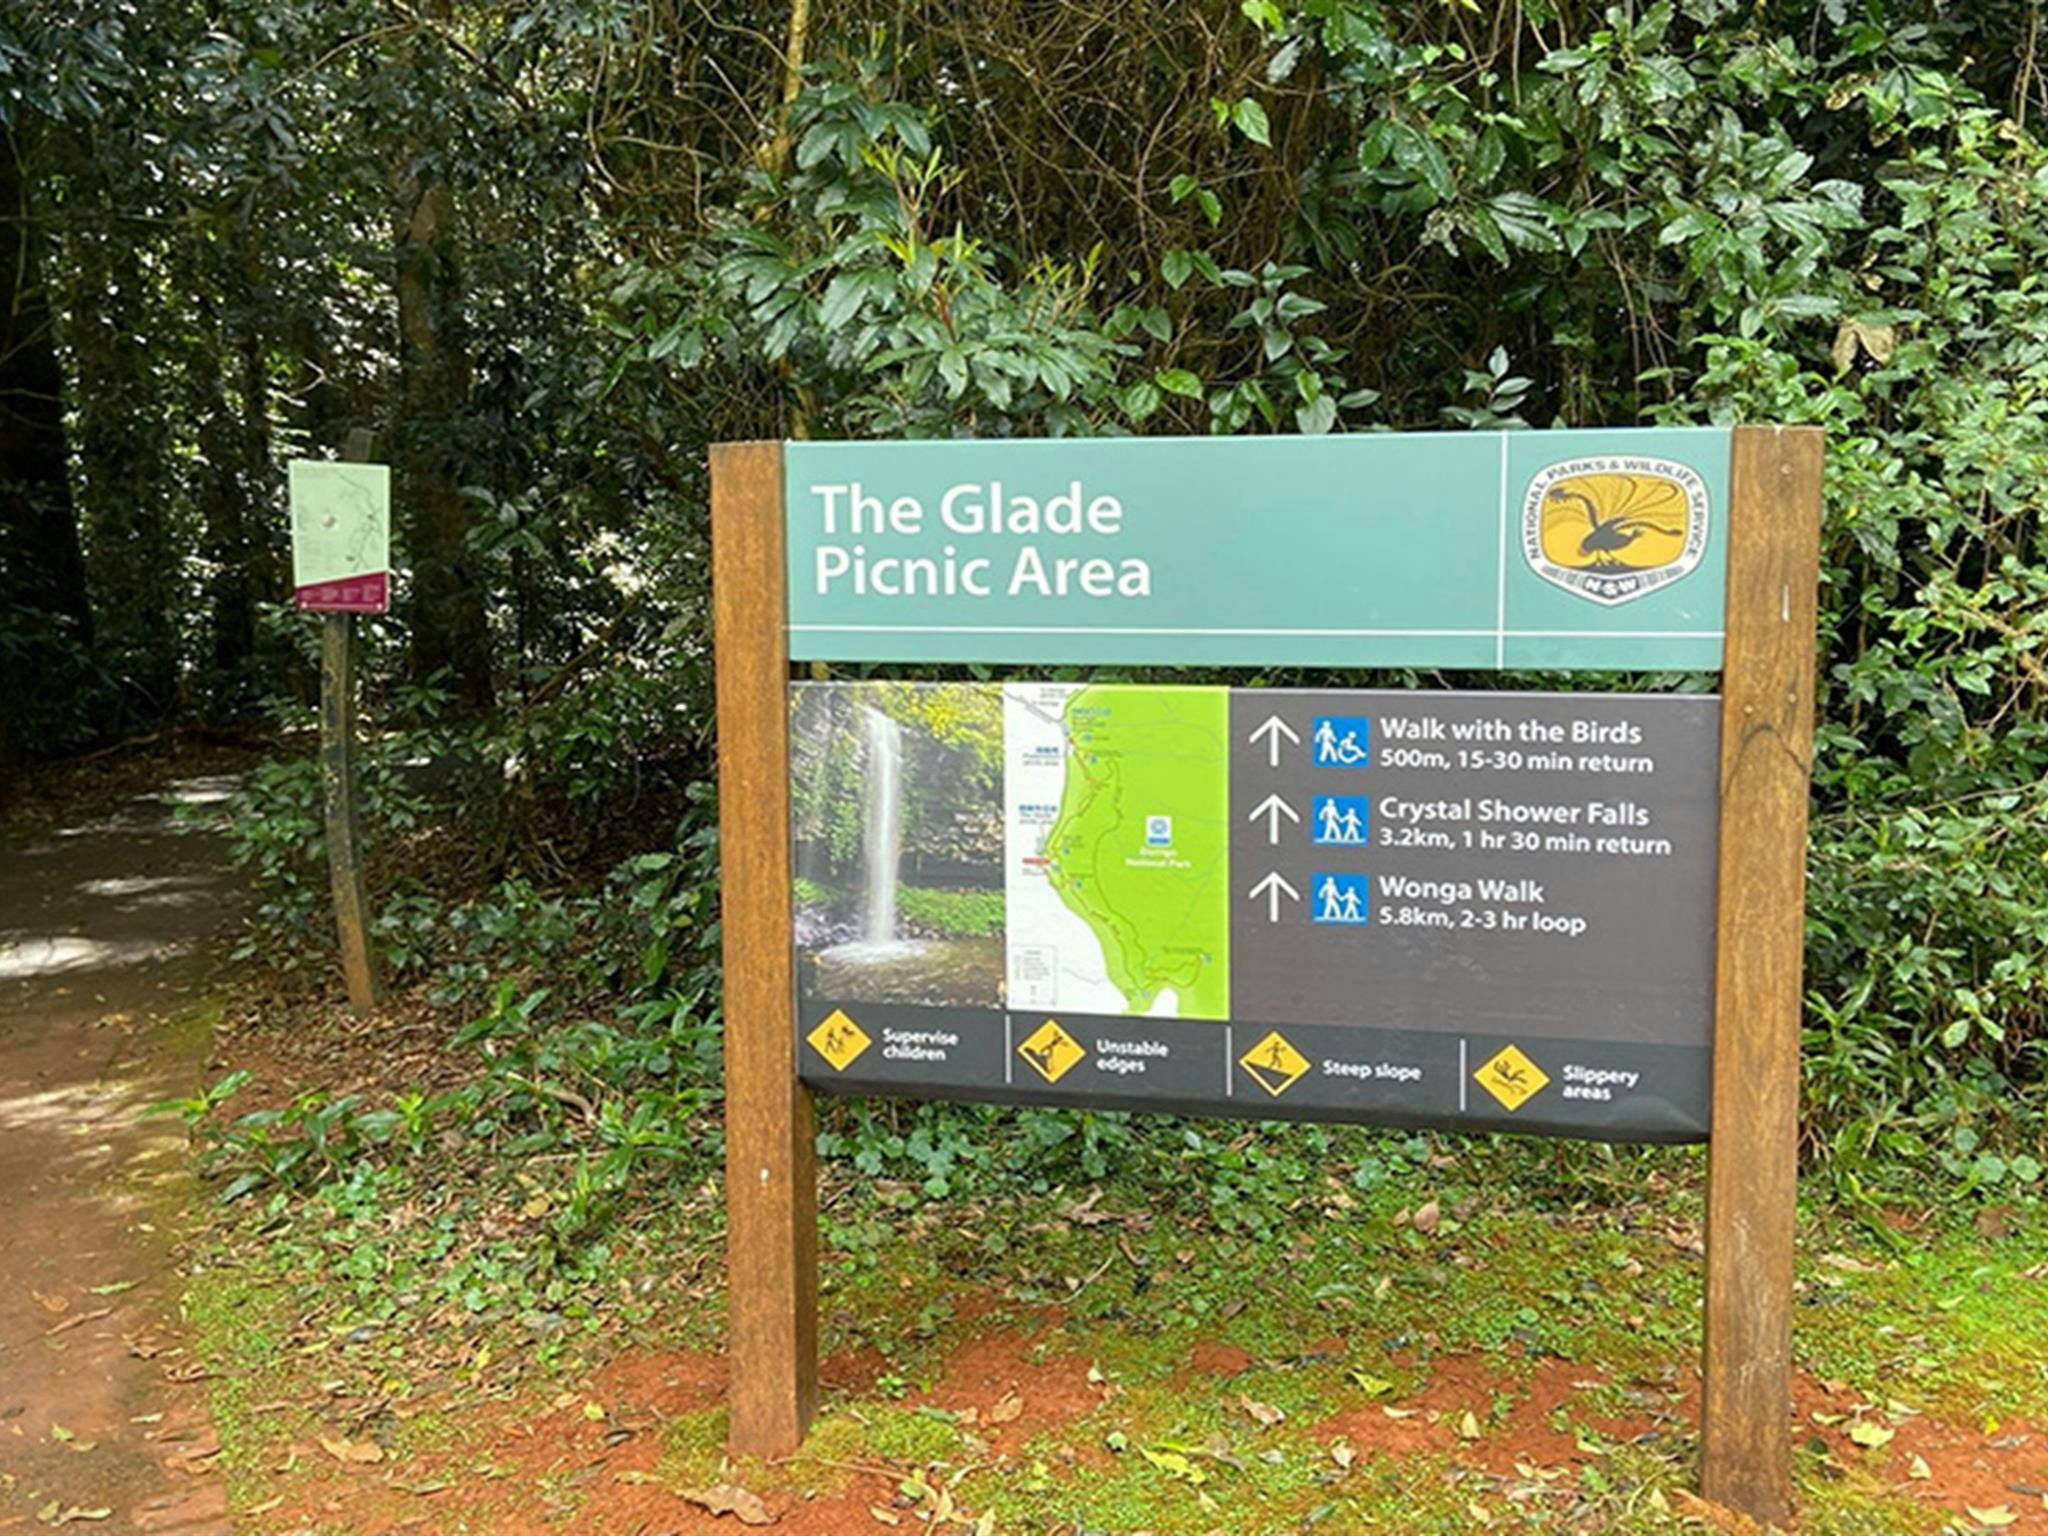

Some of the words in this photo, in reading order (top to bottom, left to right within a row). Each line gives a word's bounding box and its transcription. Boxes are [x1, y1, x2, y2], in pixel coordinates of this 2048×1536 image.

[811, 481, 924, 534] The
[940, 480, 1123, 535] Glade
[1525, 480, 1548, 560] NATIONAL
[1546, 460, 1606, 481] PARKS
[1609, 460, 1620, 470] &
[1624, 460, 1700, 490] WILDLIFE
[1686, 491, 1706, 560] SERVICE
[816, 545, 991, 596] Picnic
[1008, 546, 1152, 597] Area
[1380, 718, 1446, 740] Walk
[1452, 719, 1512, 742] with
[1518, 720, 1565, 742] the
[1572, 721, 1643, 744] Birds
[1380, 749, 1451, 770] 500m,
[1459, 750, 1523, 770] 15-30
[1527, 752, 1573, 771] min
[1578, 754, 1654, 773] return
[1379, 797, 1471, 824] Crystal
[1477, 800, 1581, 823] Shower
[1587, 802, 1650, 826] Falls
[1379, 827, 1456, 850] 3.2km,
[1462, 831, 1473, 848] 1
[1481, 831, 1506, 850] hr
[1511, 832, 1541, 850] 30
[1545, 833, 1591, 851] min
[1596, 835, 1672, 855] return
[1379, 876, 1473, 905] Wonga
[1477, 879, 1545, 903] Walk
[1379, 906, 1454, 929] 5.8km,
[1460, 911, 1497, 929] 2-3
[1503, 911, 1528, 930] hr
[1532, 912, 1587, 937] loop
[882, 1028, 959, 1047] Supervise
[1096, 1039, 1168, 1057] Unstable
[882, 1046, 946, 1061] children
[1096, 1057, 1146, 1075] edges
[1323, 1060, 1372, 1080] Steep
[1375, 1063, 1422, 1082] slope
[1562, 1064, 1639, 1087] Slippery
[1562, 1085, 1612, 1101] areas
